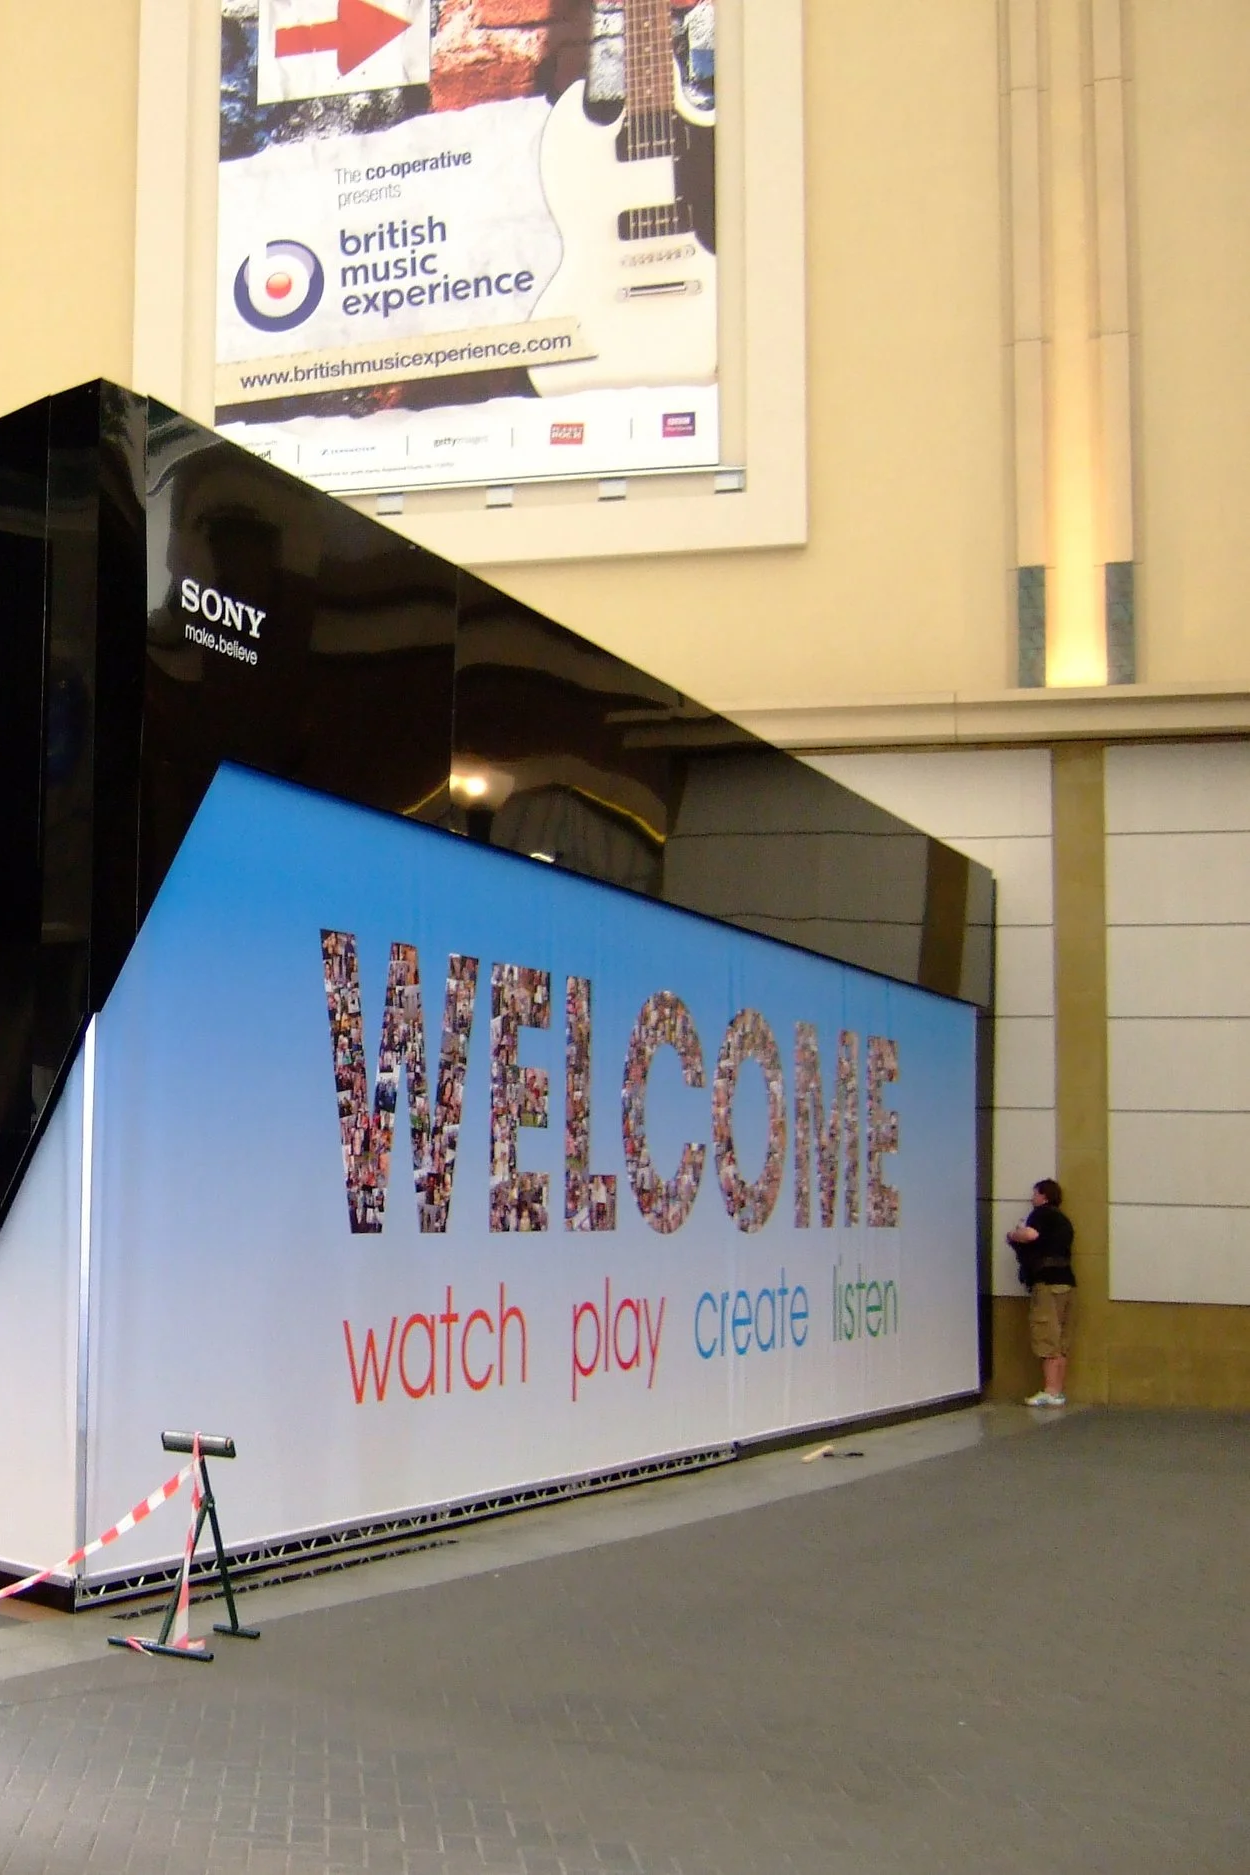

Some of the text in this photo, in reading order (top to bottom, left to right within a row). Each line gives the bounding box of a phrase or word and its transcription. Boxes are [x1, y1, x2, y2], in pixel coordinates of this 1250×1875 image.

[335, 150, 473, 185] The co-operative
[338, 183, 402, 210] presents
[340, 215, 447, 256] british
[341, 249, 438, 288] music
[342, 269, 535, 318] experience
[240, 333, 572, 389] www.britishmusicexperience.com
[181, 578, 267, 639] SONY
[185, 623, 258, 665] make.believe
[319, 928, 902, 1235] WELCOME
[342, 1253, 899, 1406] watch play create listen
